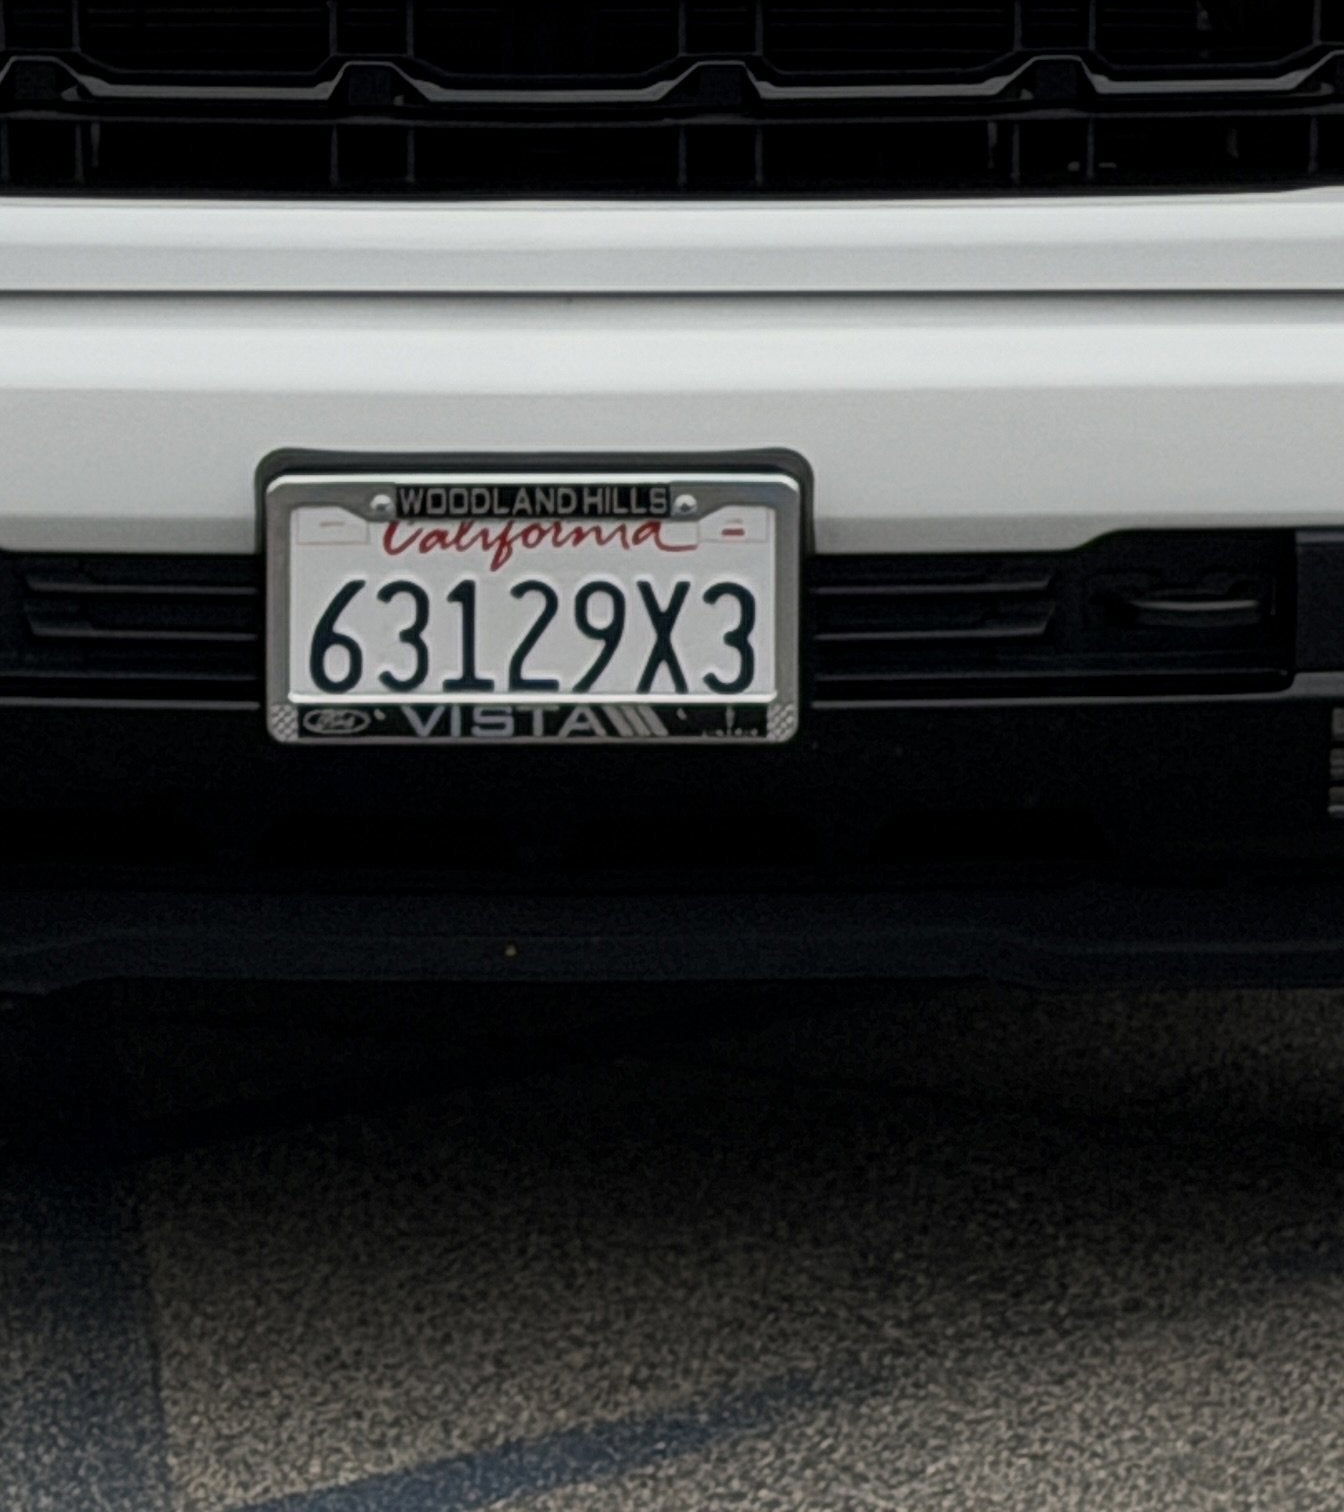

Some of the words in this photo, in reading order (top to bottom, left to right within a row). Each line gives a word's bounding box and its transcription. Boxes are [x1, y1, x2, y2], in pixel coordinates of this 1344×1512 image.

[399, 488, 577, 516] WOODLAND
[582, 488, 668, 516] HILLS
[383, 520, 698, 571] California
[309, 579, 756, 695] 63129X3
[400, 705, 607, 738] VISTA
